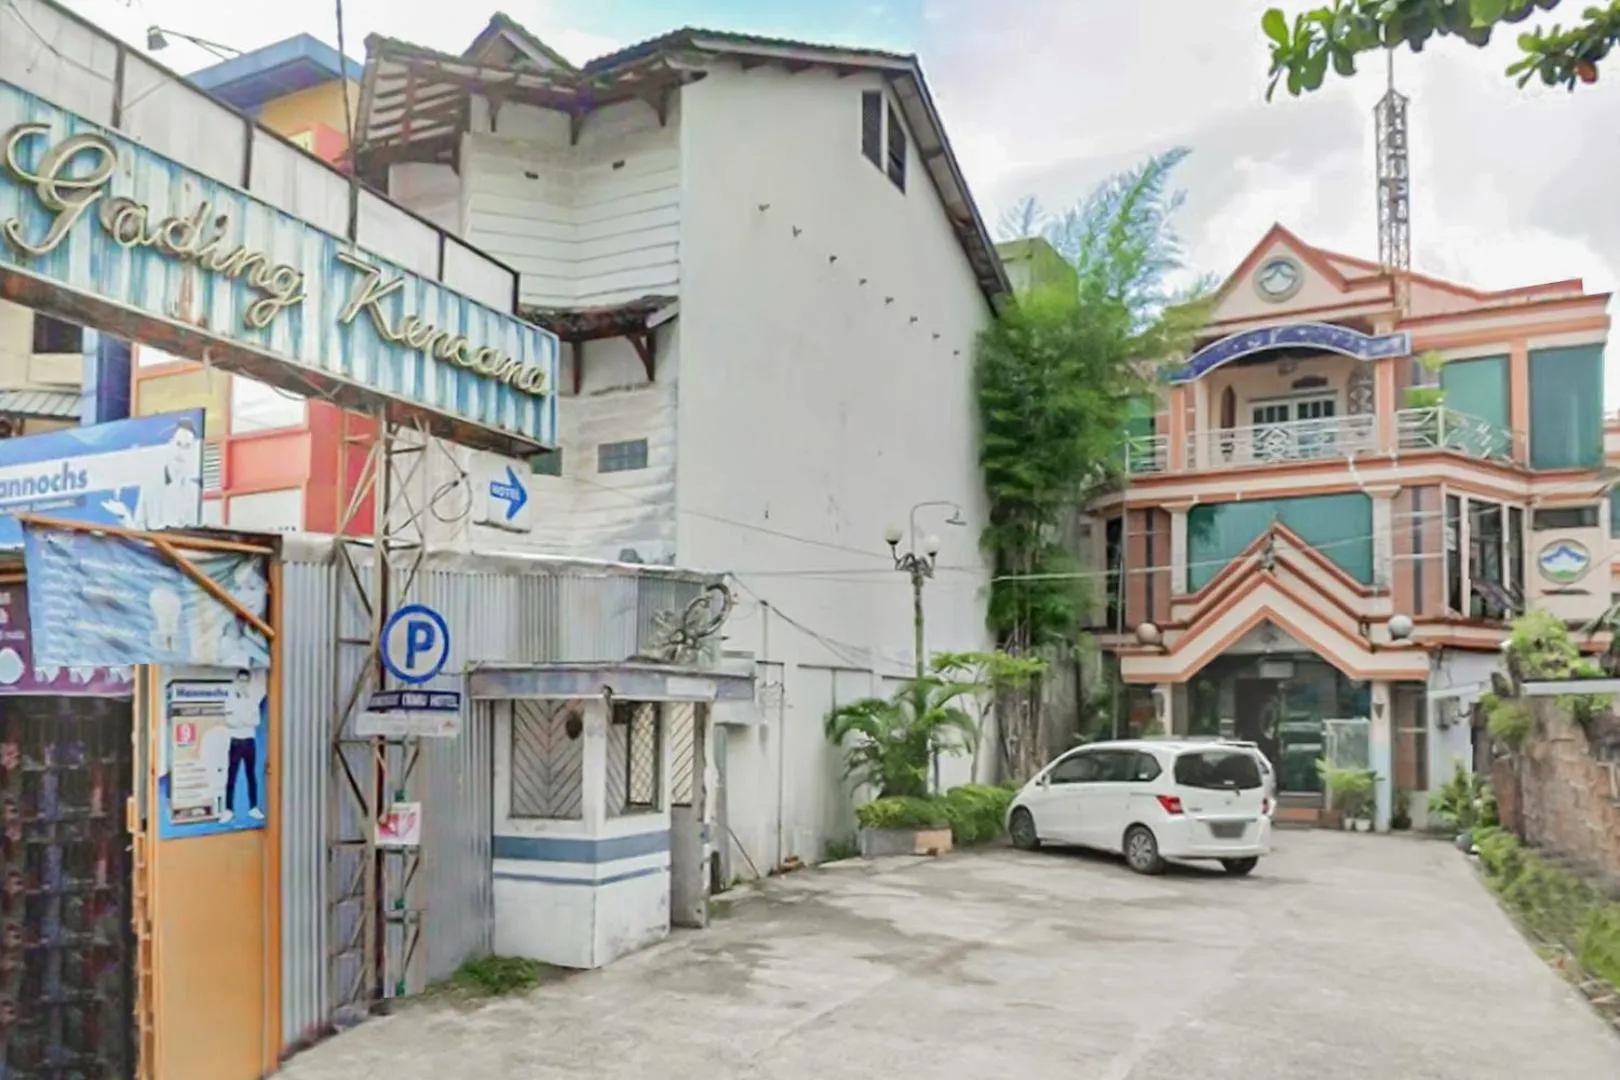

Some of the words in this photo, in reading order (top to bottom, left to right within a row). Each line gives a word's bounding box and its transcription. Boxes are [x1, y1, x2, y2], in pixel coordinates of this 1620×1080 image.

[2, 122, 307, 328] Gading
[336, 252, 549, 397] Kencana
[406, 621, 435, 669] P
